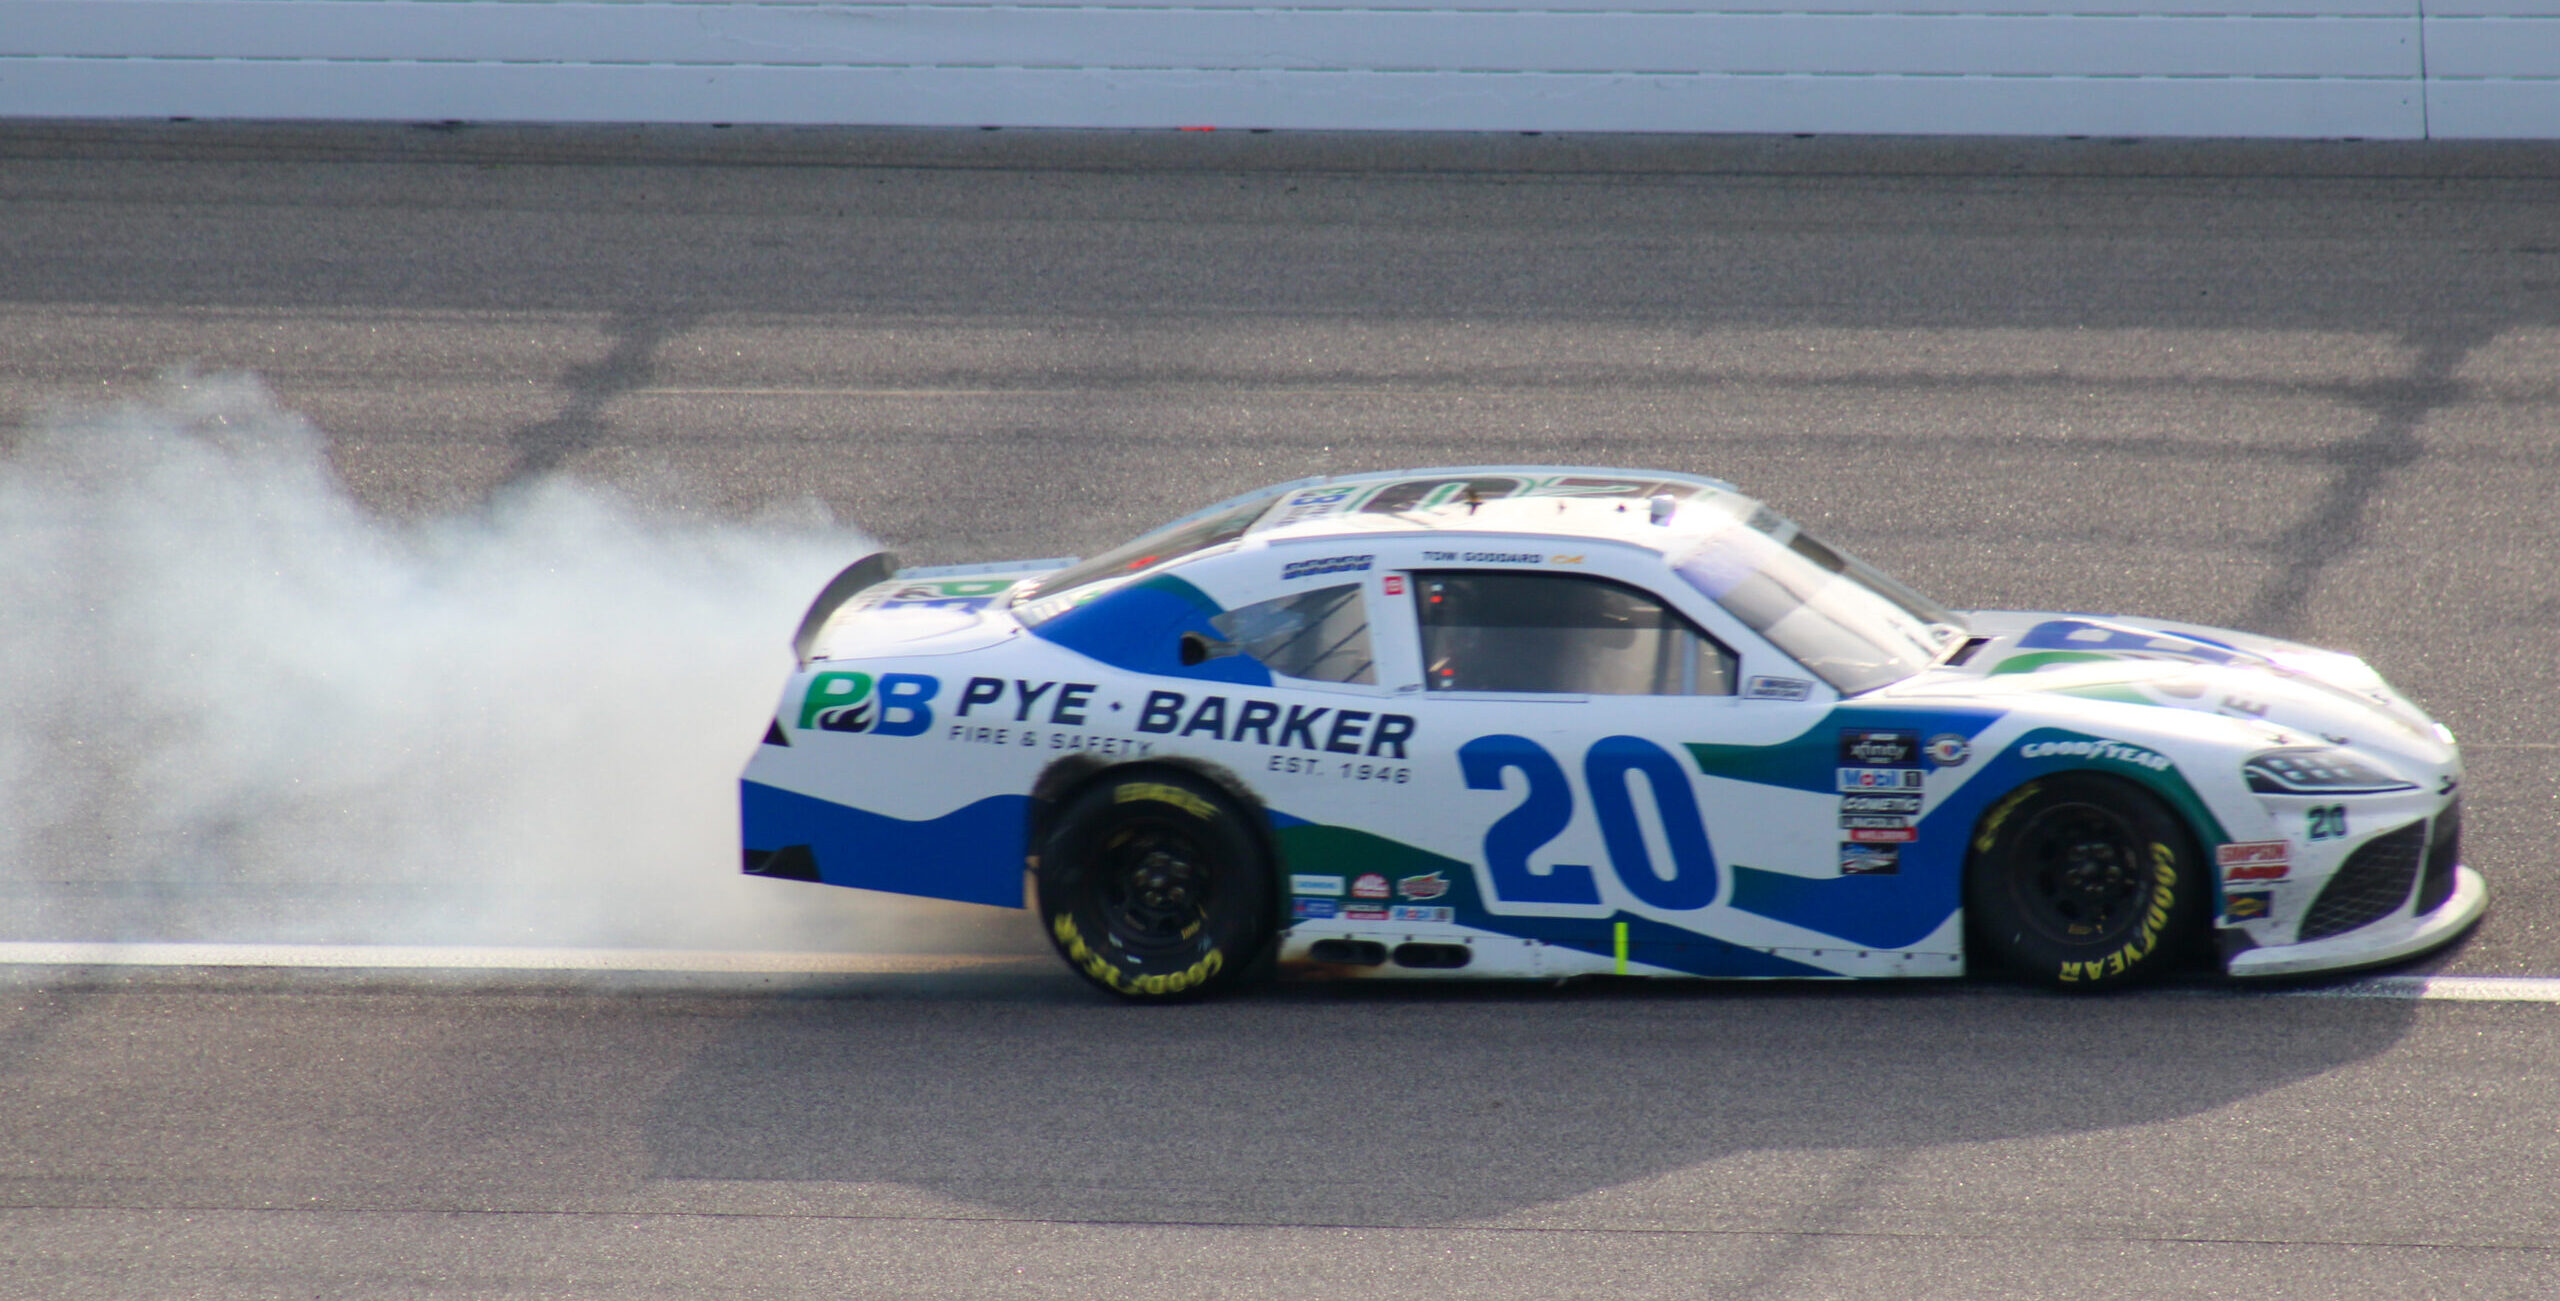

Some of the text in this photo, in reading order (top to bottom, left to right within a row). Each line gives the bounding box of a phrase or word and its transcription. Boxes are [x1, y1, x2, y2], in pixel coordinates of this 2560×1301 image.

[955, 676, 1417, 759] PYE BARKER
[949, 725, 1154, 757] FIRE & SAFETY
[2020, 740, 2173, 772] GOODYEAR
[1268, 755, 1412, 784] EST. 1946
[1845, 770, 1897, 787] Mobil
[1457, 733, 1720, 911] 20
[2308, 806, 2346, 840] 20
[2058, 841, 2177, 982] GOODYEAR
